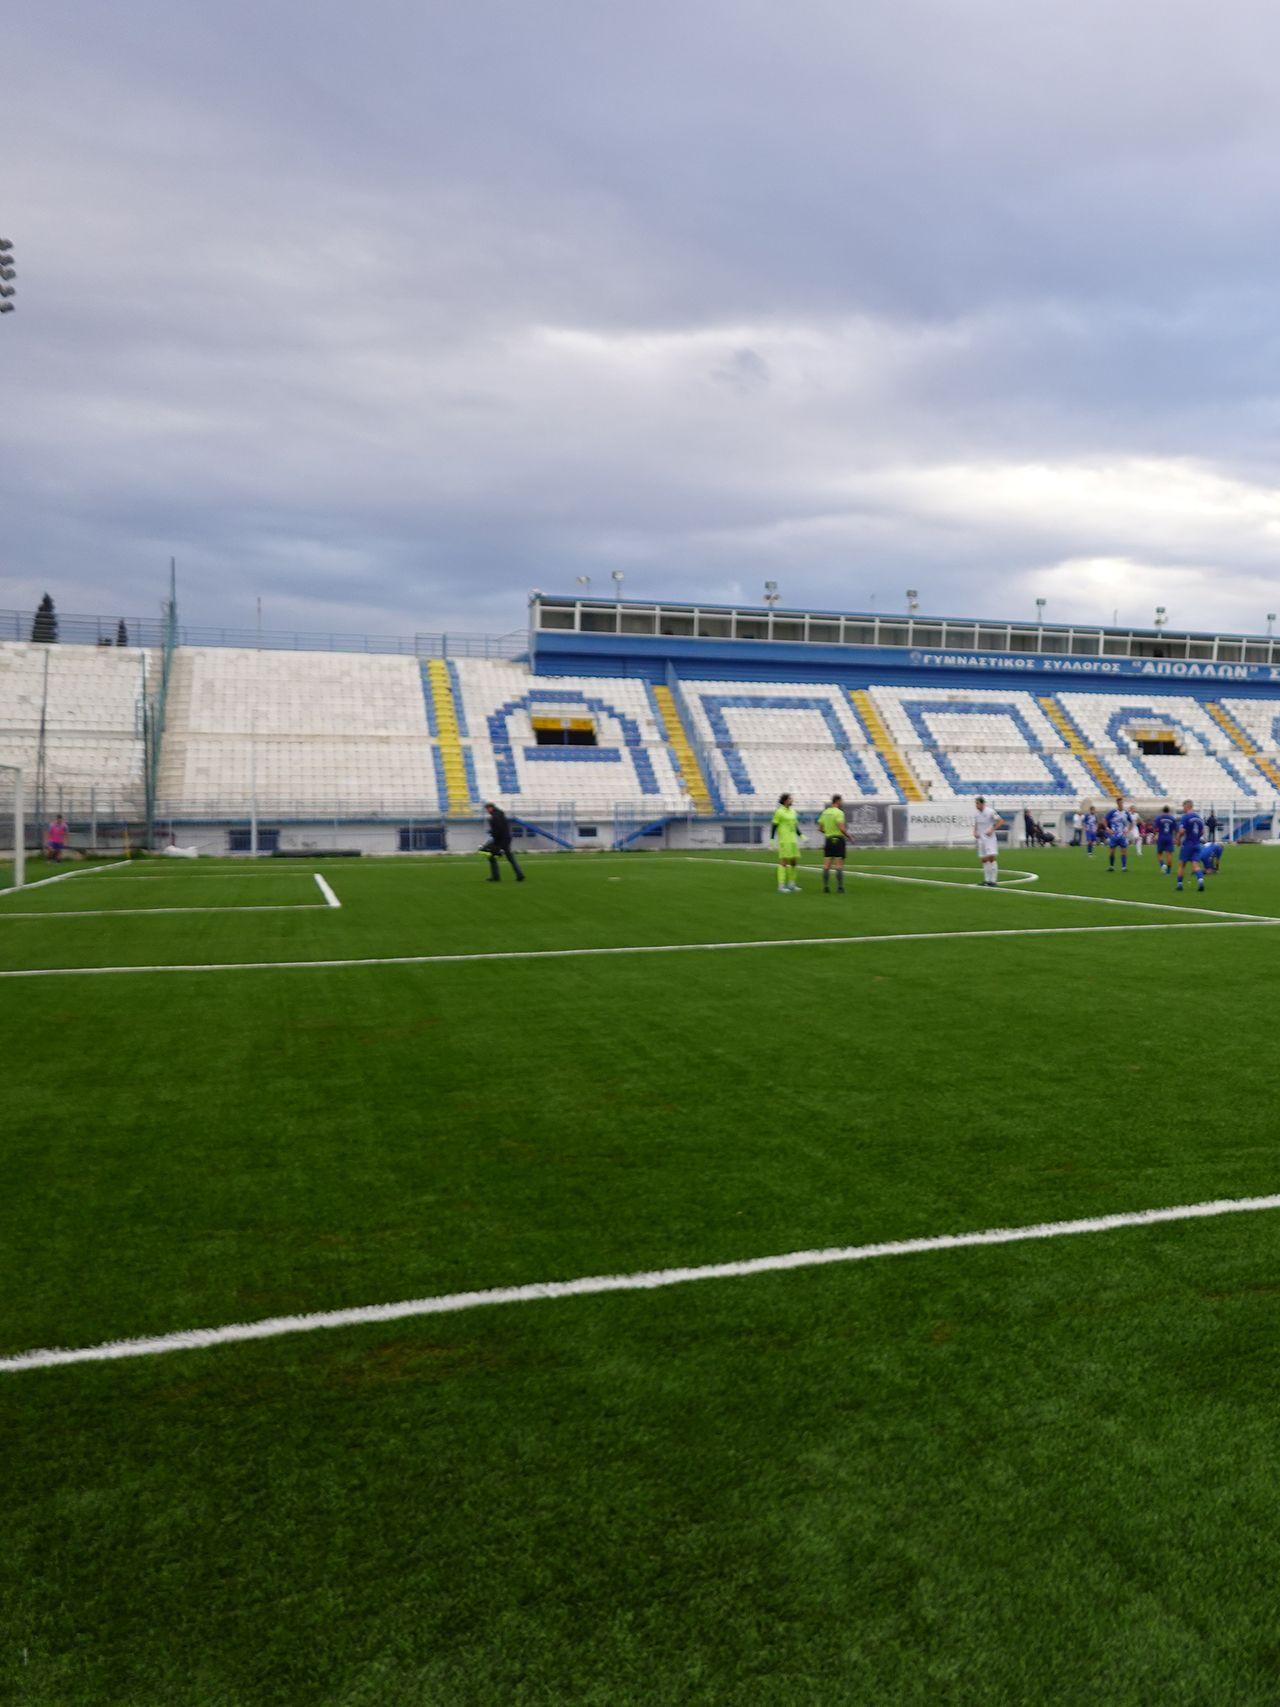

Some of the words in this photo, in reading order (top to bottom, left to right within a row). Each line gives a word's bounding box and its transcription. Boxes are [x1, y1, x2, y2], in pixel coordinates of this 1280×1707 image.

[923, 654, 1035, 669] ΓΥΜΝΑΣΤΙΚΟΣ
[1043, 660, 1121, 672] ΣΥΛΛΟΓΟΣ
[910, 815, 957, 824] PARADISE
